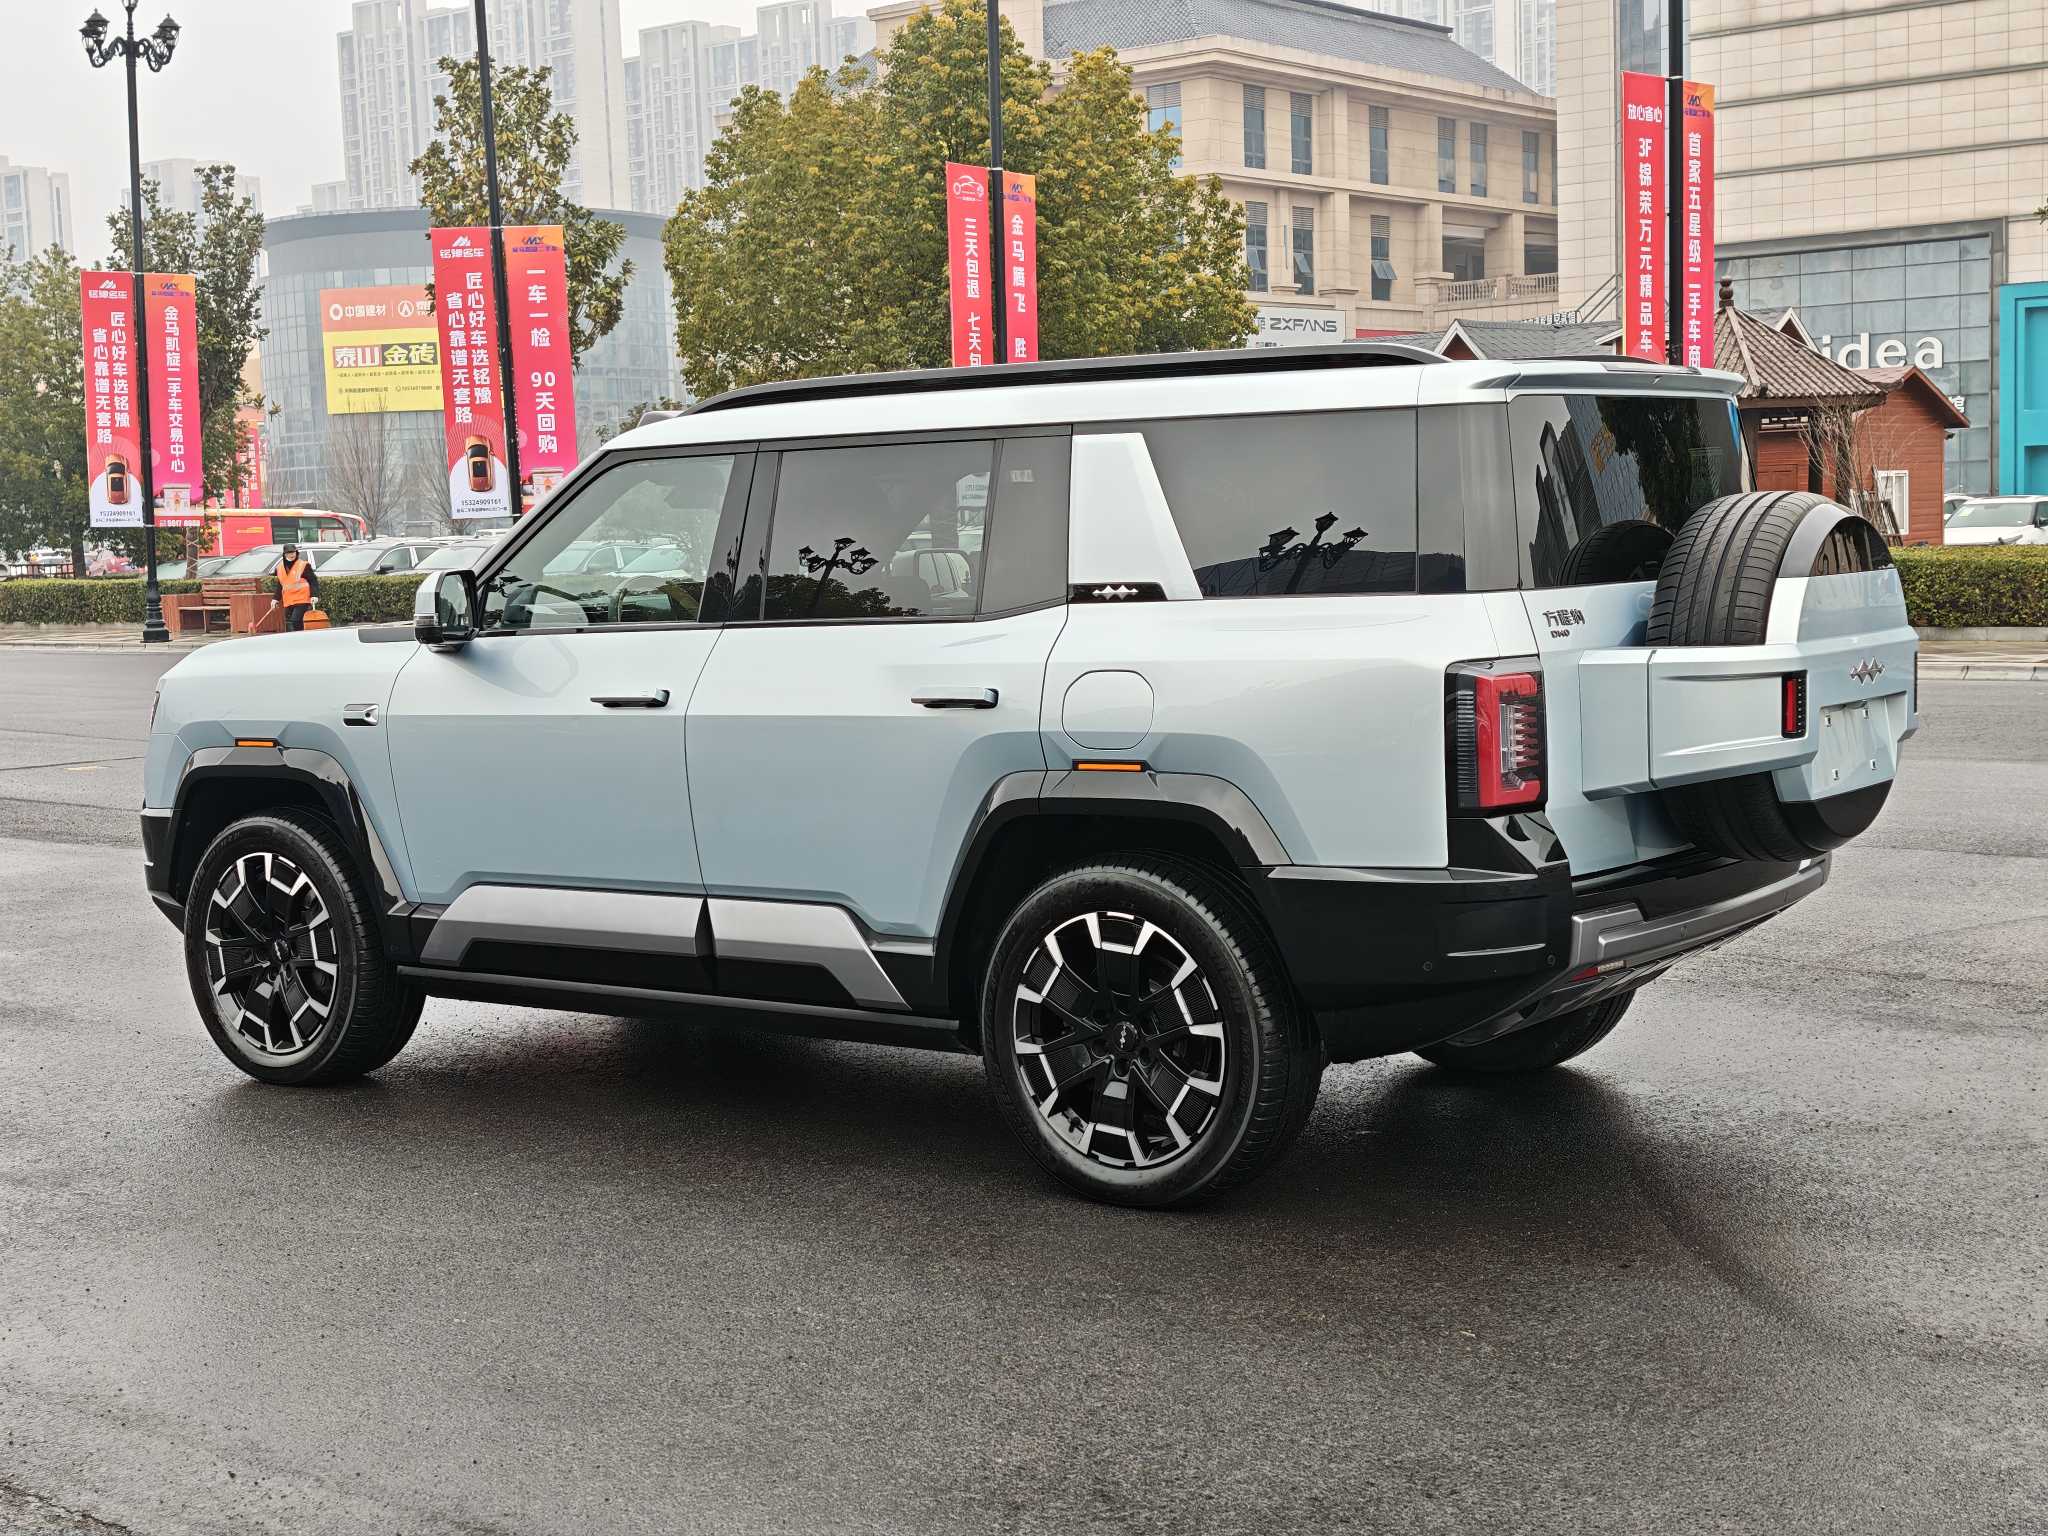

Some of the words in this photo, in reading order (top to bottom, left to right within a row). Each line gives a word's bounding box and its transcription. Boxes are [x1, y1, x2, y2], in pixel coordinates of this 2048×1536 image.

[1628, 104, 1662, 123] 放心省心
[964, 217, 980, 299] 三天包退
[465, 272, 492, 405] 匠心好车选铭豫
[526, 269, 551, 347] 一车一检
[1269, 317, 1337, 333] ZXFANS
[92, 328, 113, 444] 省心靠谱无套路
[110, 312, 130, 428] 匠心好车选铭豫
[164, 305, 185, 473] 金马凯旋二手车交易中心
[446, 292, 473, 423] 省心靠谱无套路
[1821, 332, 1944, 370] idea
[530, 372, 558, 453] 90天回购
